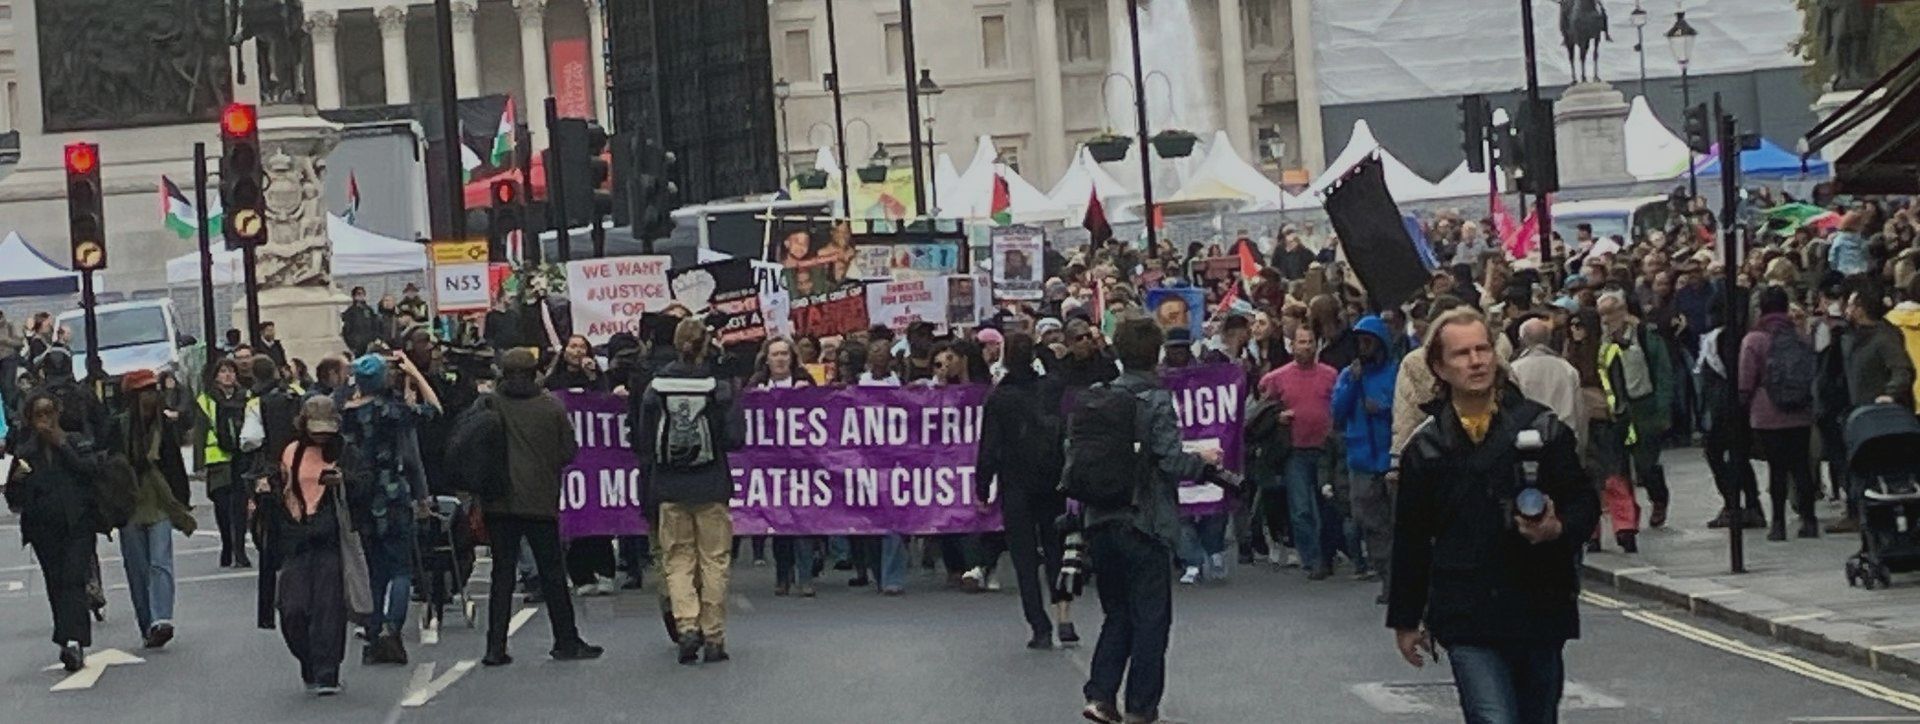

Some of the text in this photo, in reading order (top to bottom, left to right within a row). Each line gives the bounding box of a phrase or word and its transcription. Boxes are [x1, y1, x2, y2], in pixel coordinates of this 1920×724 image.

[583, 262, 663, 279] WE WANT
[445, 275, 481, 291] N53
[587, 284, 664, 301] #JUSTICE
[567, 411, 631, 448] NITE
[840, 407, 908, 446] AND
[728, 468, 832, 507] EATHS
[845, 467, 878, 506] IN
